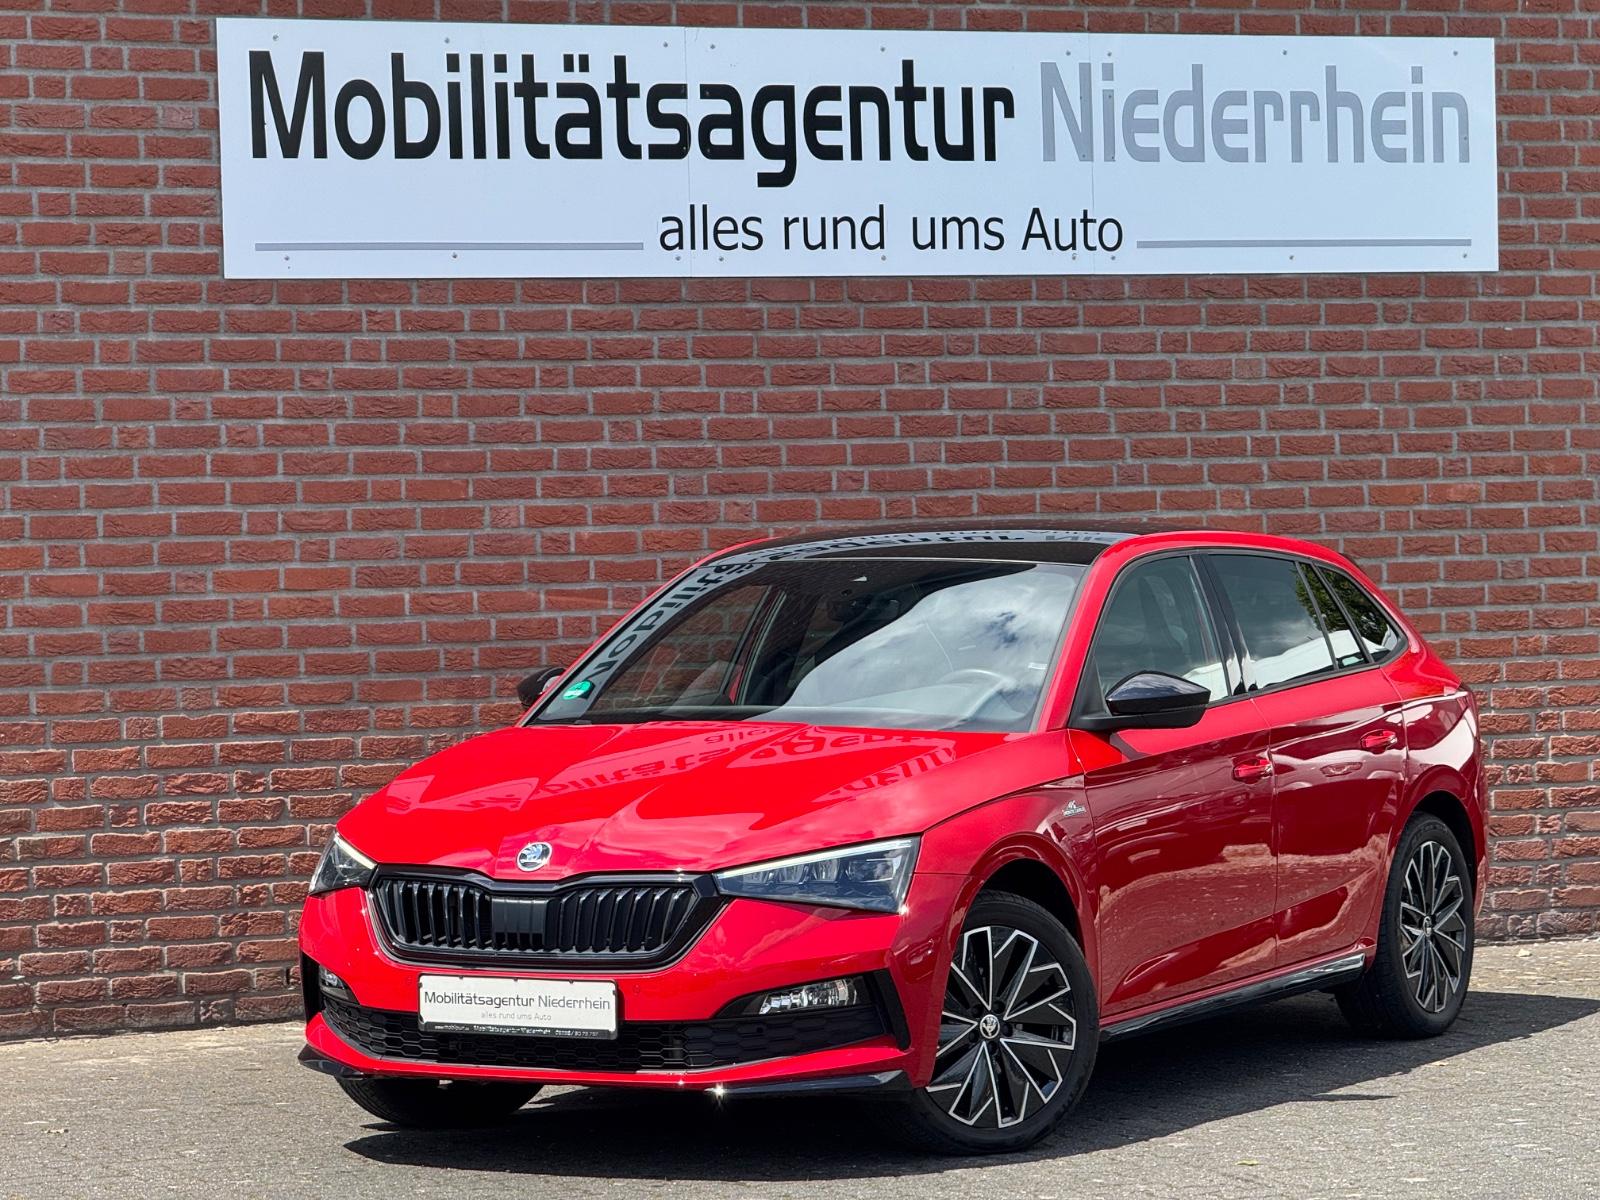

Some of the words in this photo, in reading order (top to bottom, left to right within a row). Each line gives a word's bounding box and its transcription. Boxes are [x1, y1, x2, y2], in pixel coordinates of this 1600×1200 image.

[249, 51, 1014, 187] Mobilitätsagentur
[1040, 62, 1470, 164] Niederrhein
[660, 204, 763, 251] alles
[784, 204, 884, 251] rund
[912, 216, 1005, 251] ums
[1022, 207, 1123, 251] Auto
[424, 991, 535, 1010] Mobilitätsagentur
[538, 995, 610, 1010] Niederrhein
[498, 1011, 515, 1020] rund
[533, 1012, 552, 1021] Auto
